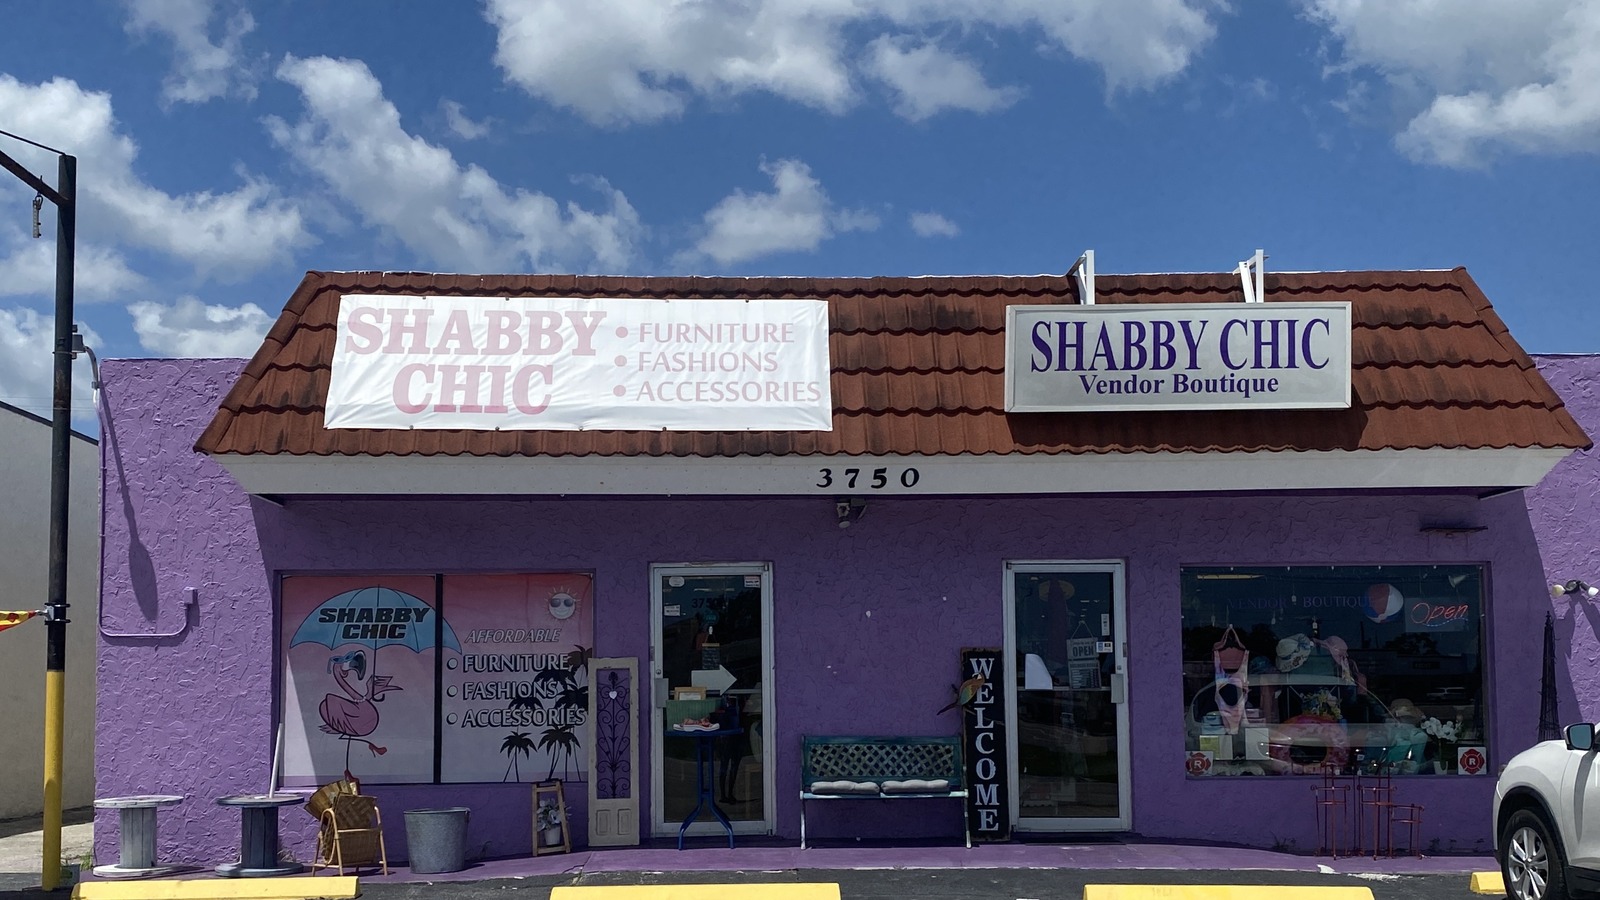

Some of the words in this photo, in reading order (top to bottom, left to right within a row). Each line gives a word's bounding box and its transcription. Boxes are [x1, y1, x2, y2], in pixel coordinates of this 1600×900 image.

[344, 306, 608, 356] SHABBY
[639, 322, 795, 344] FURNITURE
[1030, 319, 1210, 373] SHABBY
[1219, 317, 1331, 371] CHIC
[638, 351, 778, 373] FASHIONS
[392, 362, 554, 415] CHIC
[636, 380, 822, 403] ACCESSORIES
[1079, 373, 1165, 395] Vendor
[1171, 372, 1279, 399] Boutique
[816, 467, 920, 489] 3750
[1227, 597, 1292, 610] VENDOR
[1410, 602, 1469, 624] Open
[318, 607, 431, 623] SHABBY
[341, 624, 407, 640] CHIC
[464, 628, 561, 643] AFFORDABLE
[1072, 645, 1094, 657] OPEN
[463, 653, 570, 672] FURNITURE
[463, 681, 559, 700] FASHIONS
[461, 708, 587, 728] ACCESSORIES
[969, 658, 1000, 831] WELCOME
